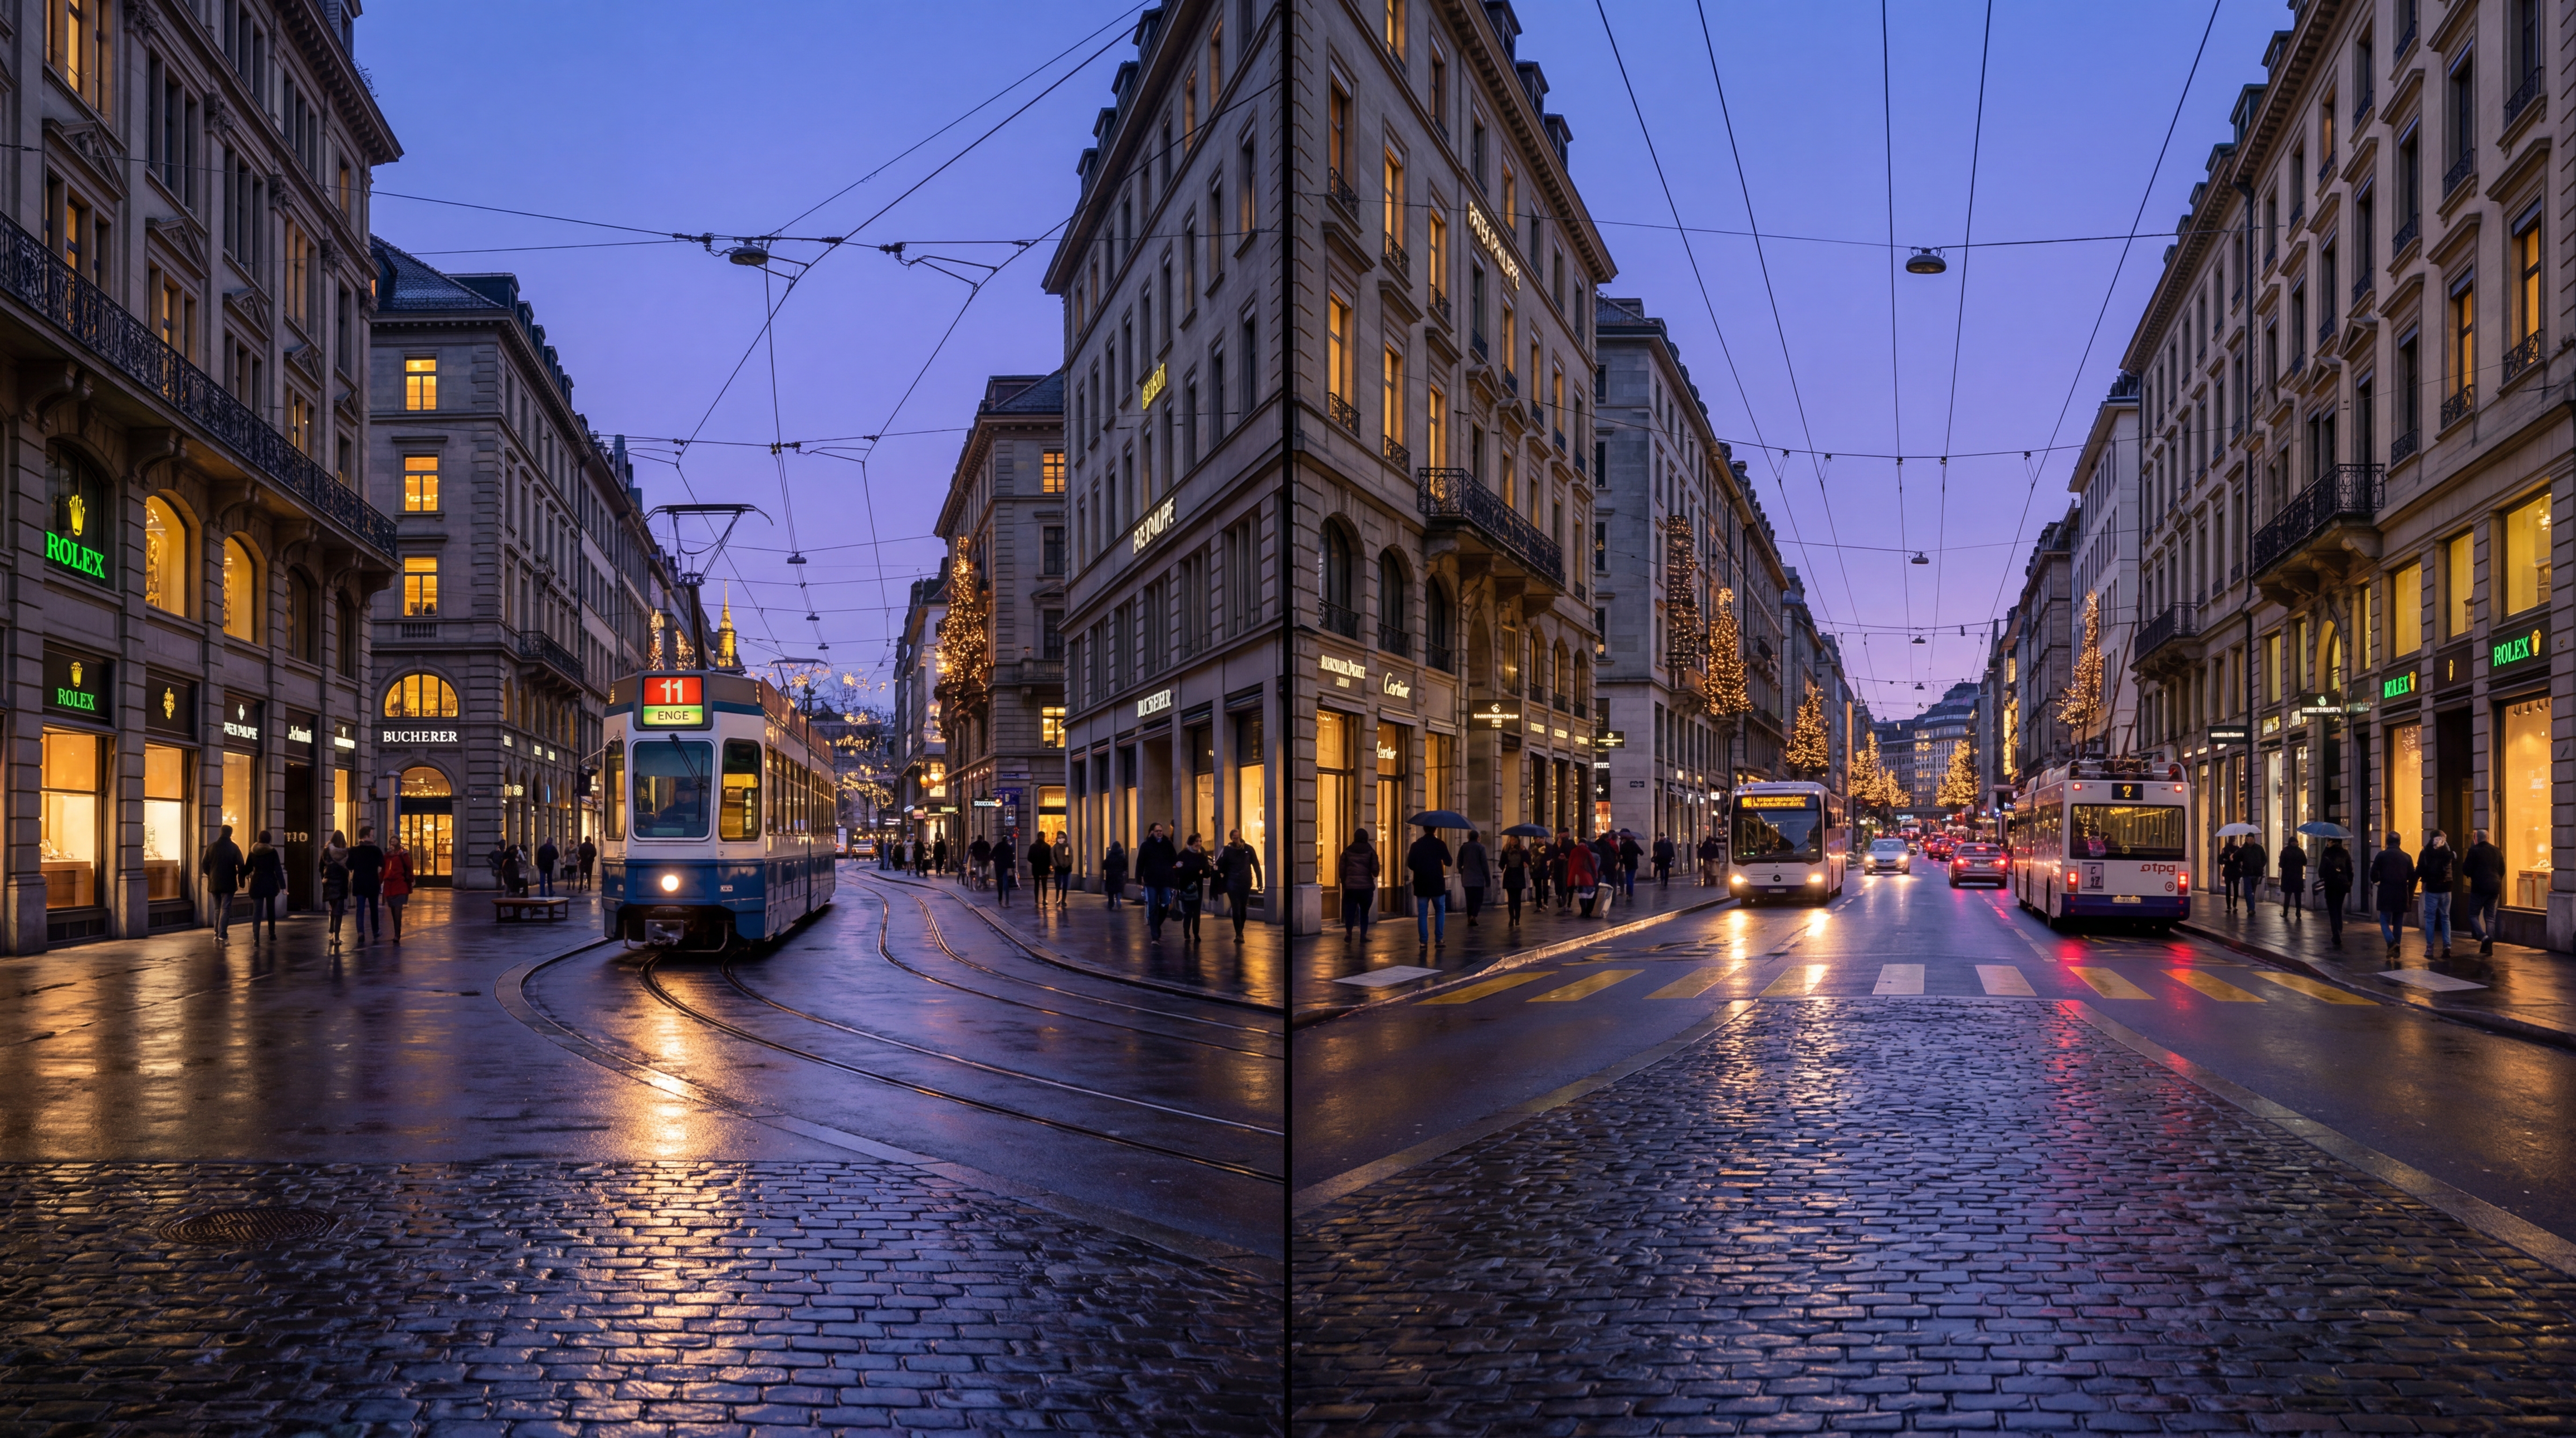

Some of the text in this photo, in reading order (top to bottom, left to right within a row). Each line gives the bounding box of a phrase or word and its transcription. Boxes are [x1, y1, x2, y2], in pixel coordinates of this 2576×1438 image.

[46, 531, 105, 579] ROLEX
[2494, 636, 2529, 667] ROLEX
[58, 688, 95, 711] ROLEX
[660, 679, 683, 703] 11
[658, 711, 689, 720] ENGE
[383, 731, 458, 742] BUCHERER
